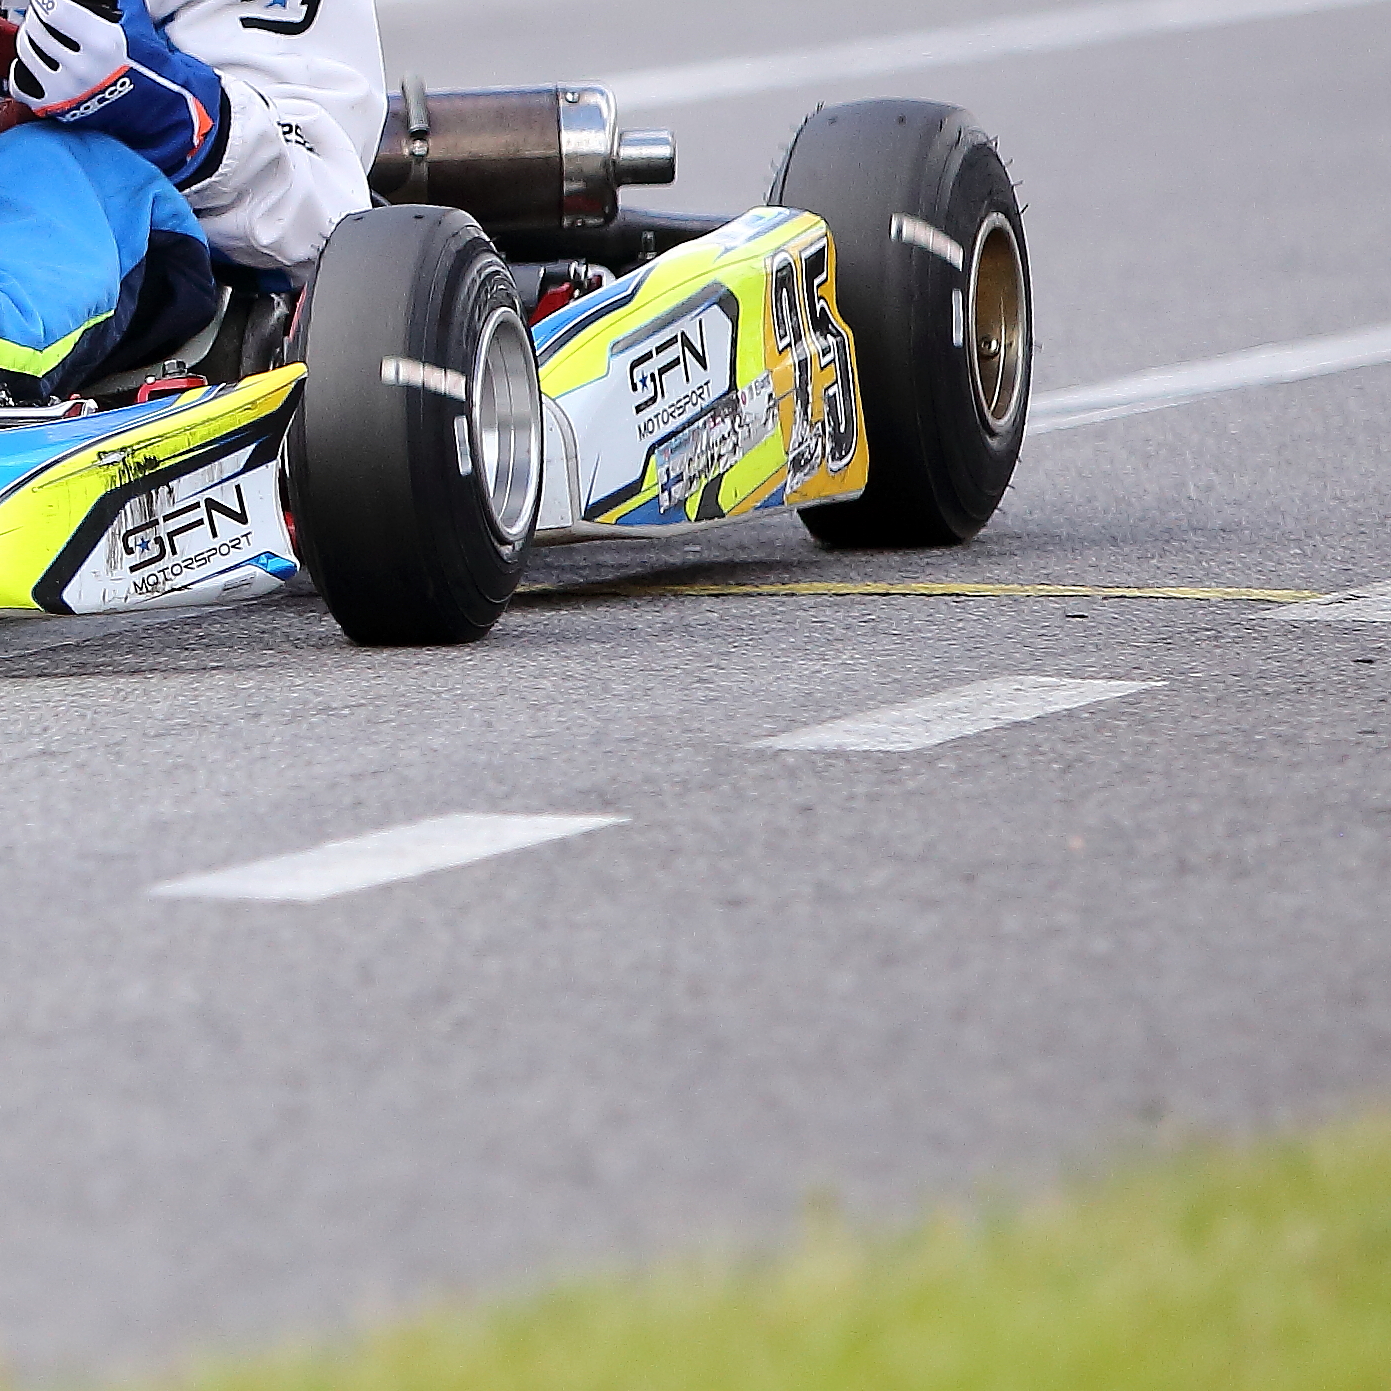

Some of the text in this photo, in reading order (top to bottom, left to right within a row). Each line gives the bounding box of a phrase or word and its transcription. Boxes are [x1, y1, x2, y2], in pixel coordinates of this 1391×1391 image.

[628, 317, 710, 415] SFN
[637, 380, 712, 441] MOTORSPORT
[122, 484, 249, 573] SFN
[132, 531, 253, 595] MOTORSPORT
